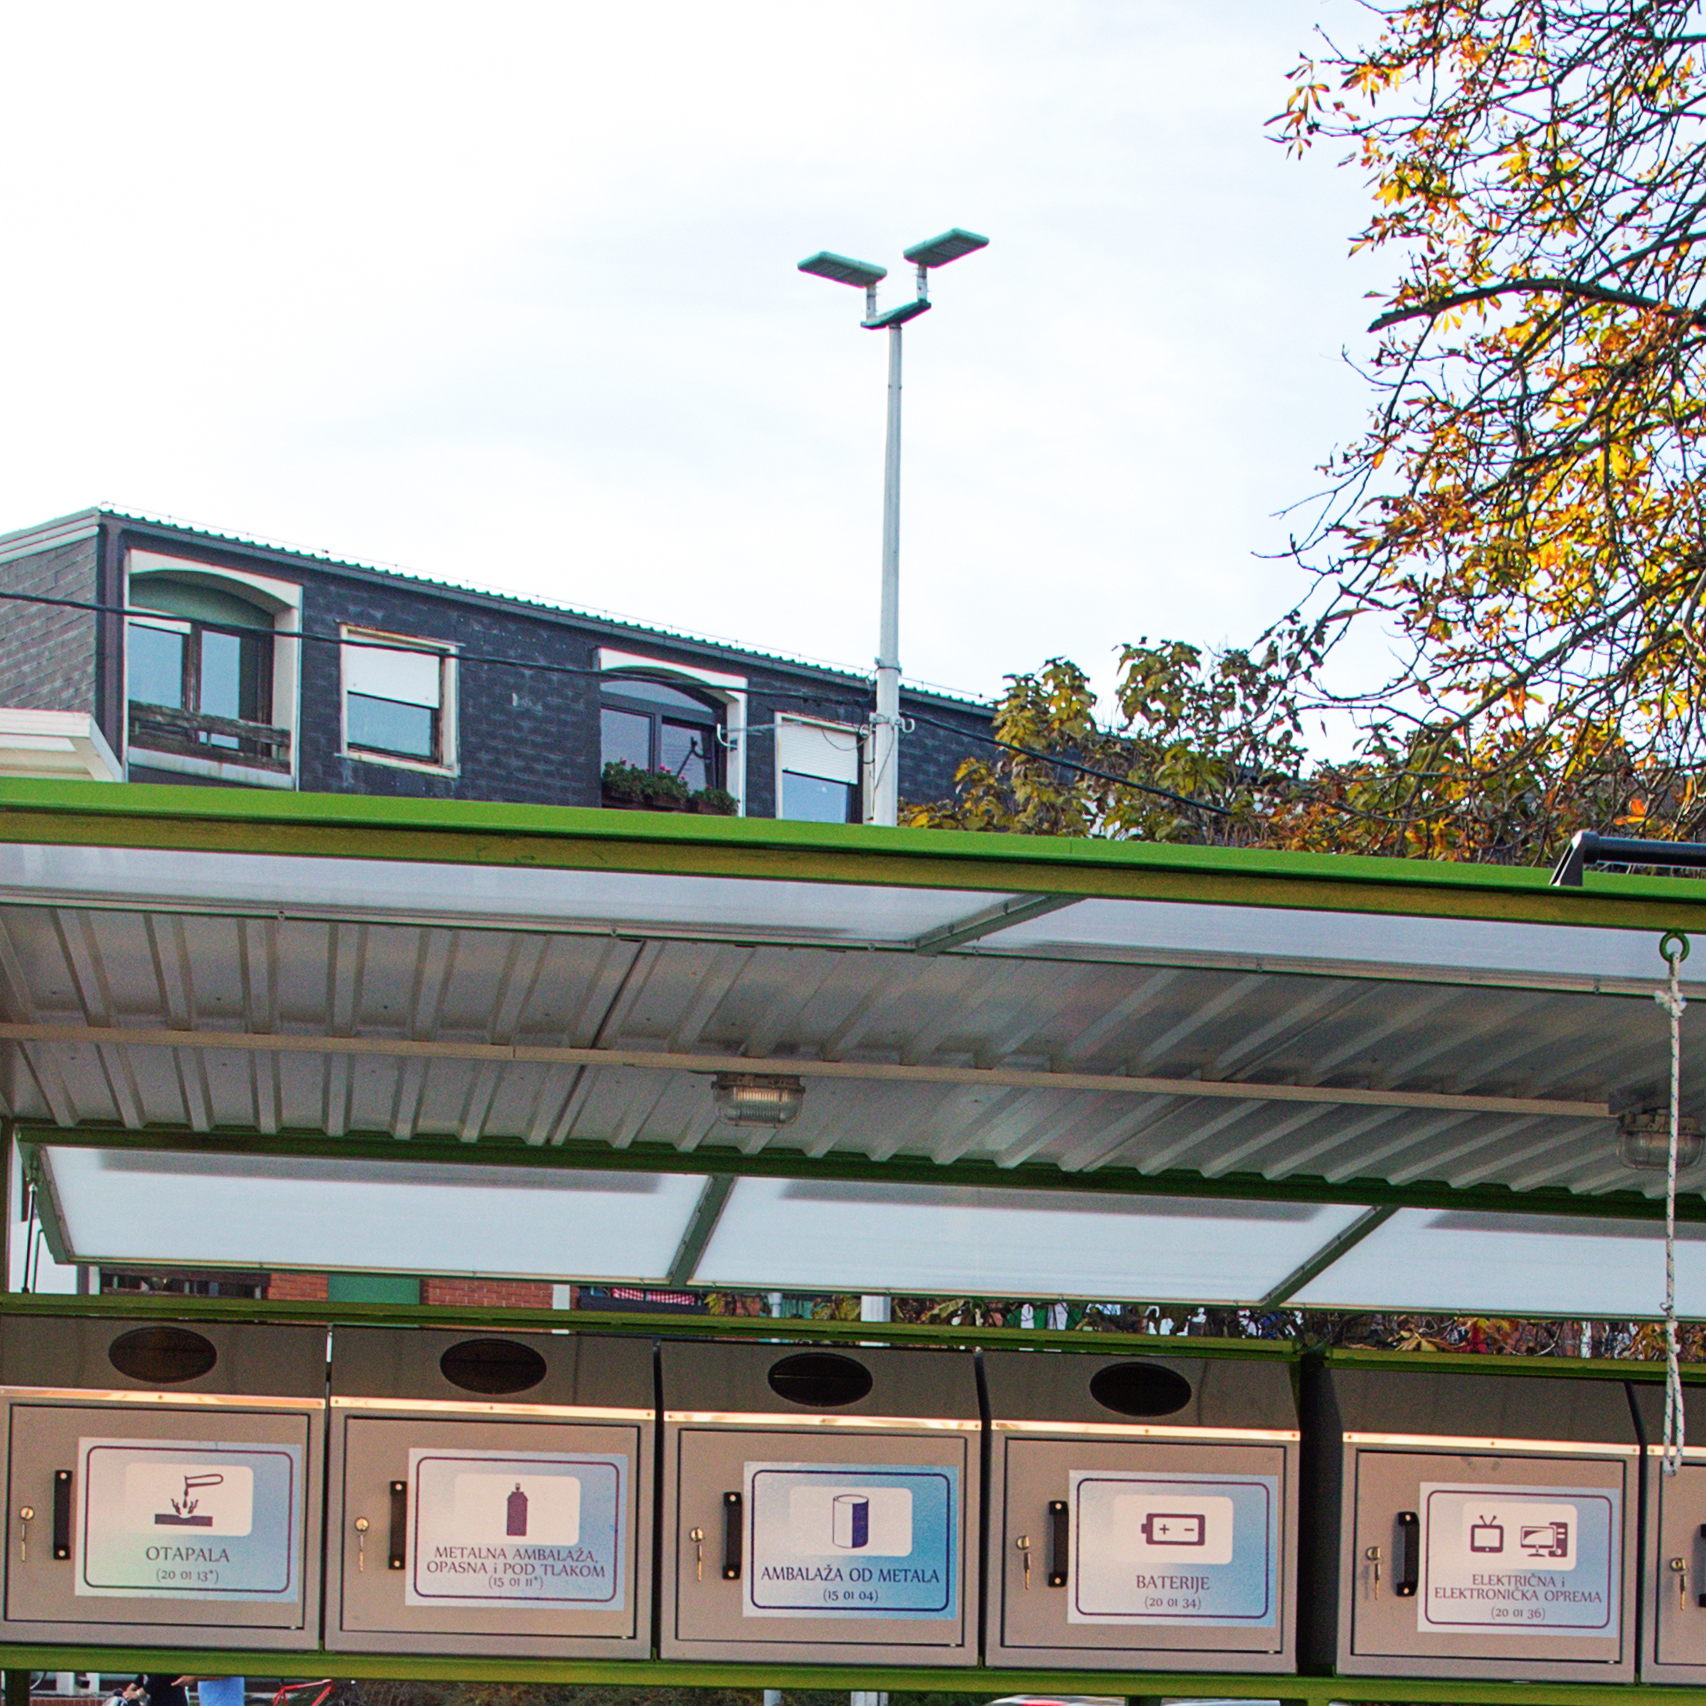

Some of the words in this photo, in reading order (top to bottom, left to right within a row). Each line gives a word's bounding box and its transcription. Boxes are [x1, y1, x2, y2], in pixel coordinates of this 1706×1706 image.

[145, 1546, 230, 1563] OTAPALA
[435, 1546, 507, 1561] METALNA
[512, 1546, 598, 1565] AMBALAŽA,
[156, 1569, 175, 1583] (20
[178, 1570, 193, 1581] 01
[427, 1561, 490, 1574] OPASNA
[493, 1562, 499, 1574] i
[502, 1562, 536, 1576] POD
[540, 1563, 606, 1578] TLAKOM
[761, 1564, 844, 1584] AMBALAŽA
[849, 1568, 872, 1582] OD
[878, 1568, 939, 1584] METALA
[488, 1575, 504, 1589] (15
[508, 1577, 521, 1588] 01
[1136, 1574, 1210, 1593] BATERIJE
[1472, 1572, 1558, 1588] ELEKTRIČNA
[1561, 1577, 1566, 1588] i
[823, 1588, 839, 1602] (15
[843, 1590, 854, 1600] 01
[858, 1589, 878, 1602] 04)
[1145, 1595, 1162, 1609] (20
[1166, 1597, 1178, 1607] 01
[1182, 1596, 1201, 1610] 34)
[1435, 1585, 1538, 1602] ELEKTRONIČKA
[1544, 1590, 1601, 1604] OPREMA
[1491, 1605, 1509, 1621] (20
[1512, 1607, 1524, 1618] 01
[1527, 1606, 1546, 1621] 36)
